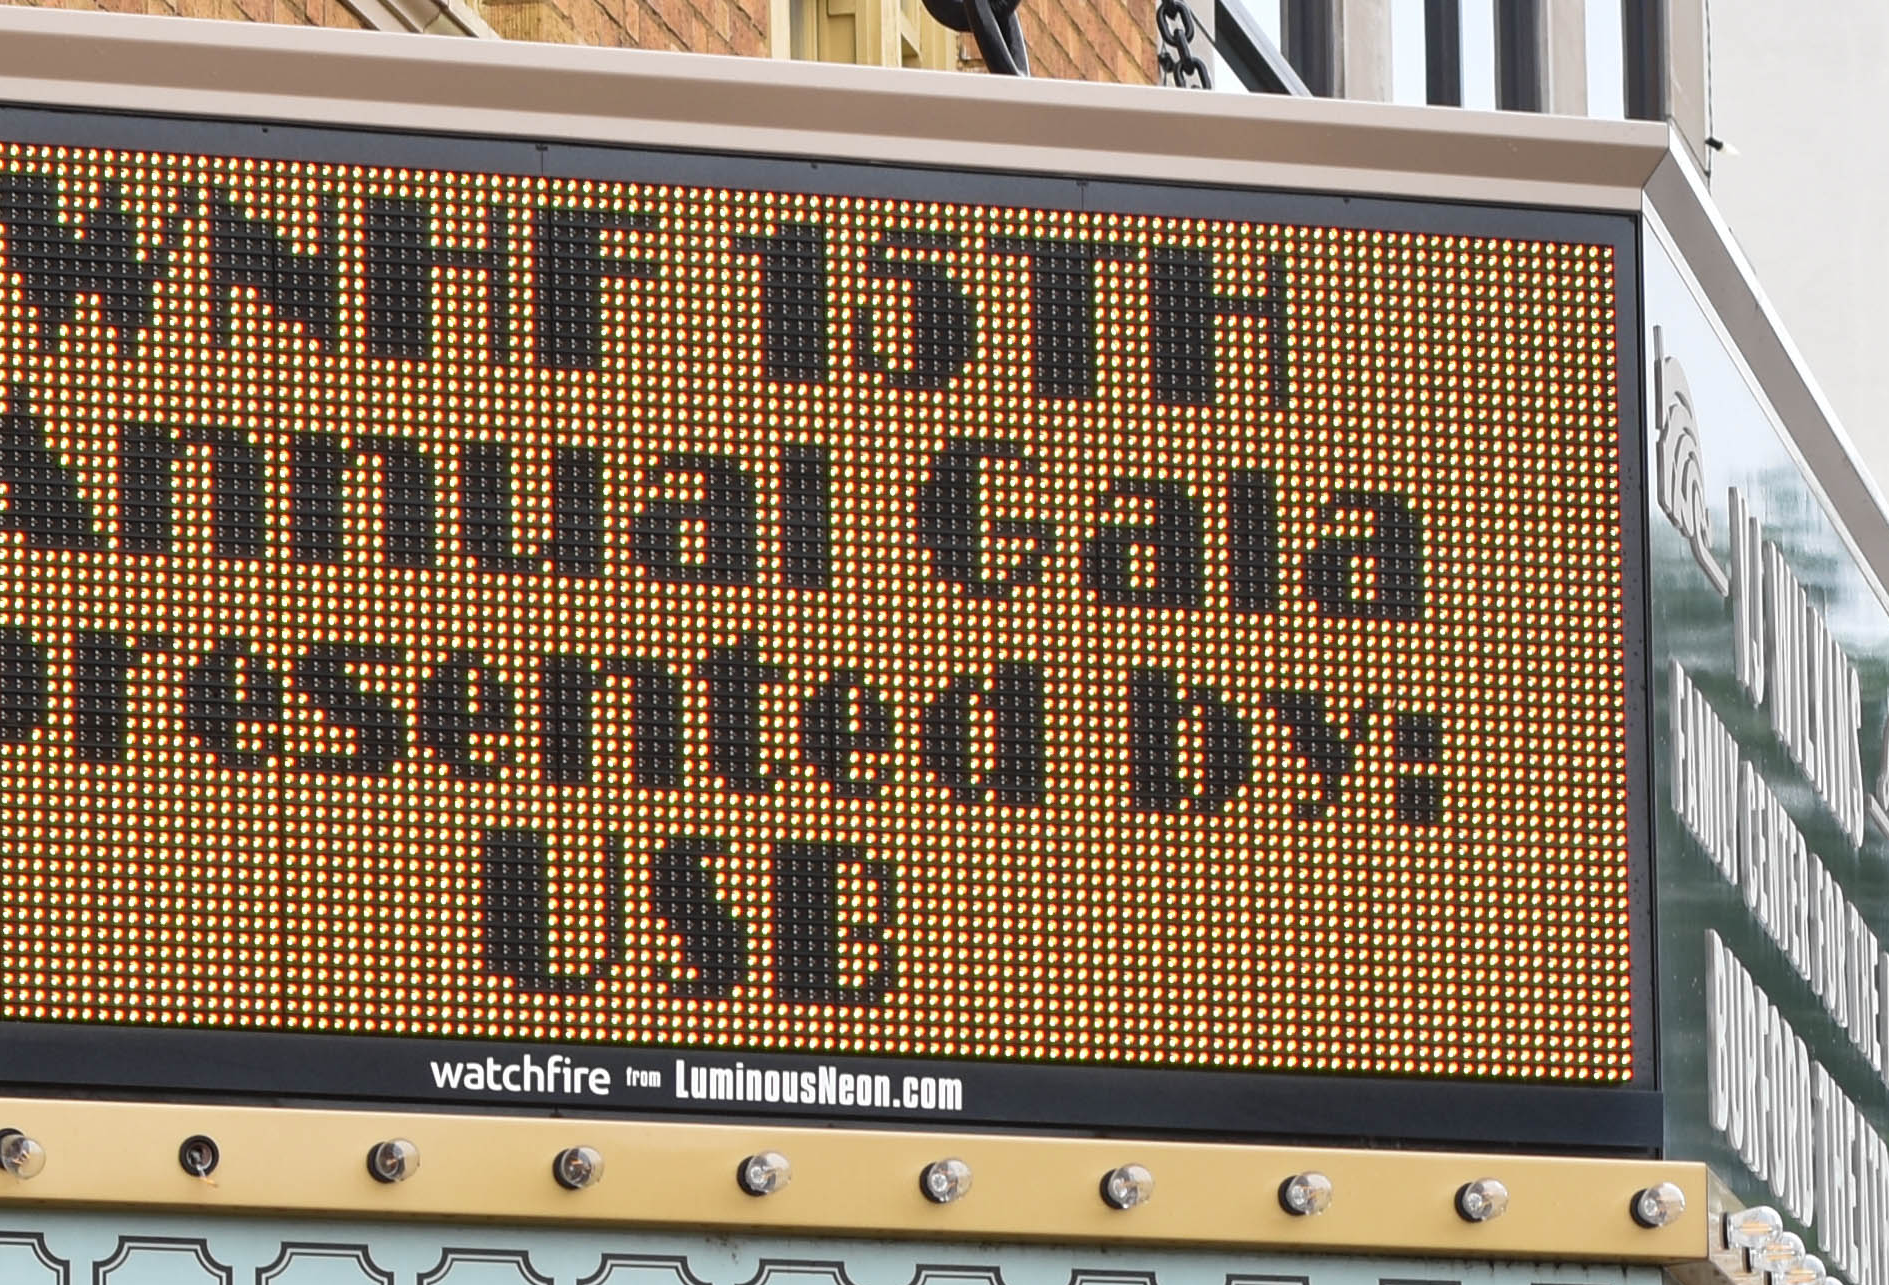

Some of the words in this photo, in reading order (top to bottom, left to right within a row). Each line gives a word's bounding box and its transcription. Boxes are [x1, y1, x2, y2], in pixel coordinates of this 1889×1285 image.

[729, 222, 1289, 409] 15TH
[915, 438, 1424, 622] Gala
[1130, 667, 1441, 825] by:
[1762, 539, 1864, 849] WILKINS
[482, 828, 895, 1004] USB
[1670, 658, 1739, 886] FAMILY
[1739, 760, 1811, 981] CENTER
[1810, 852, 1848, 1029] FOR
[1846, 901, 1882, 1072] THE
[430, 1055, 611, 1097] watchfire
[626, 1067, 661, 1088] from
[675, 1059, 963, 1111] LuminousNeon.com
[1705, 927, 1814, 1228] BURFORD
